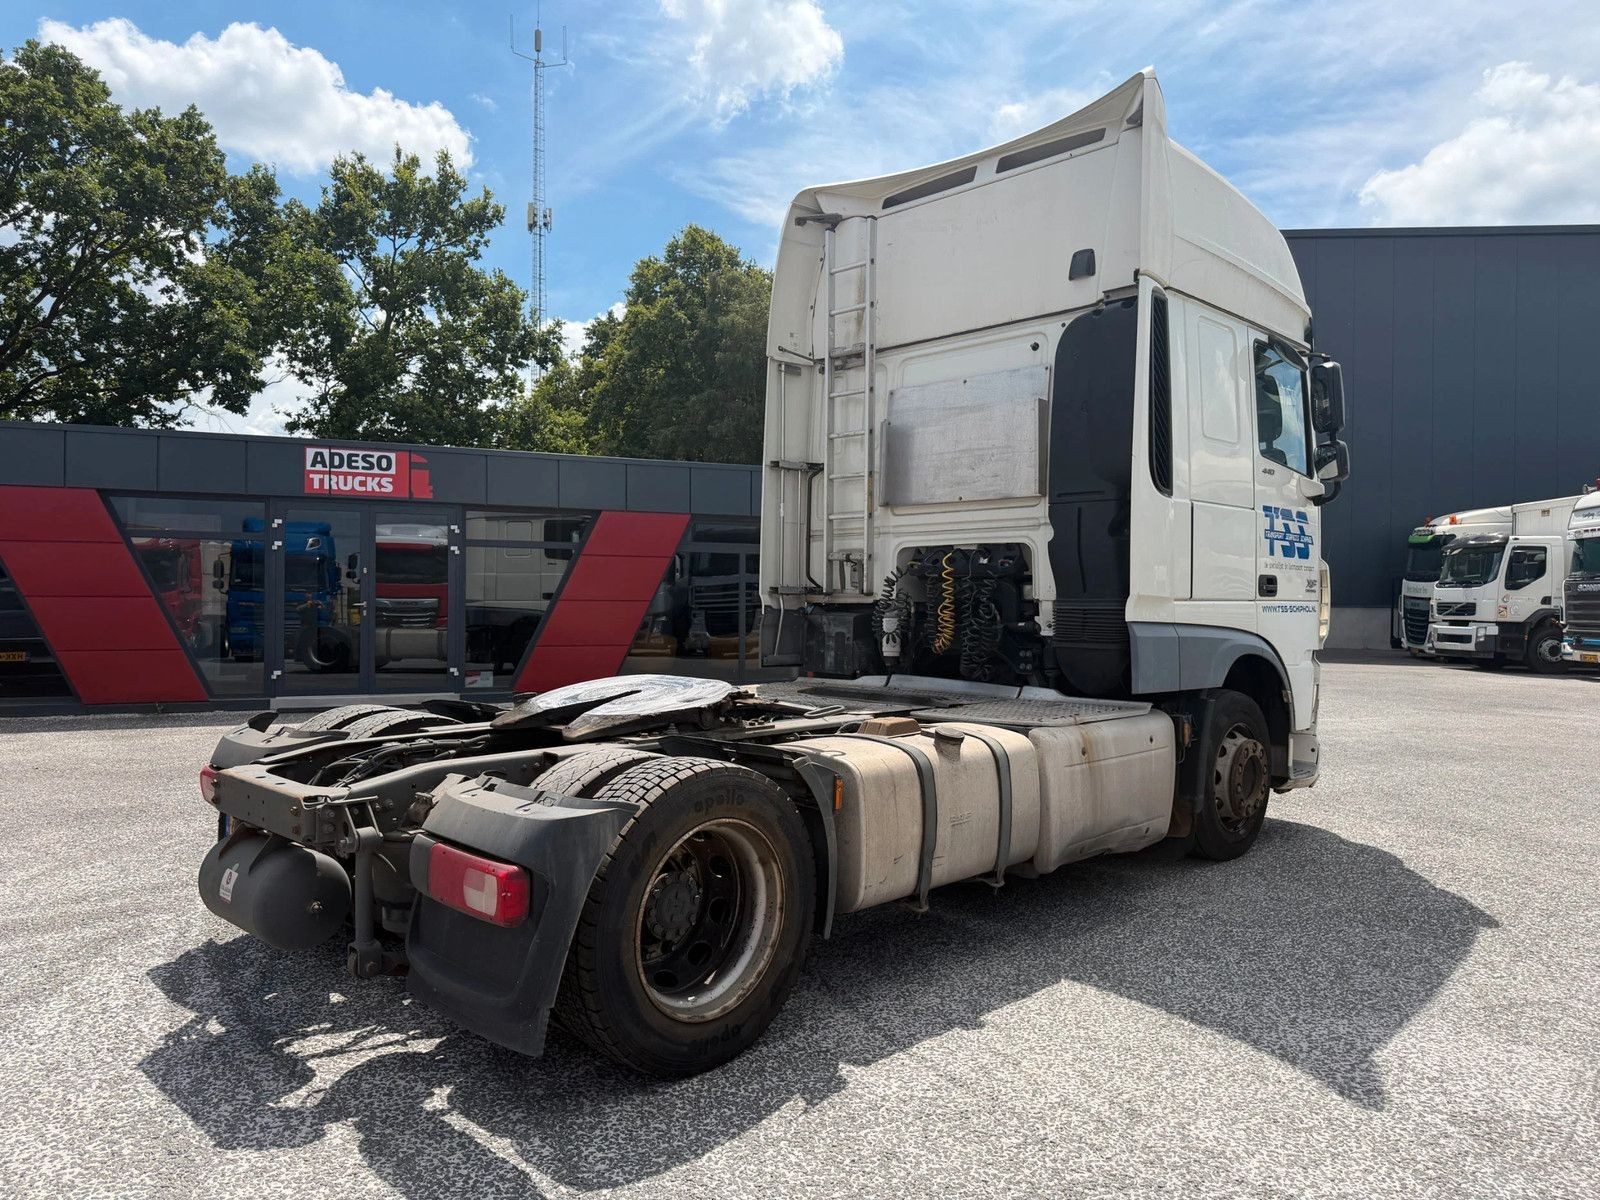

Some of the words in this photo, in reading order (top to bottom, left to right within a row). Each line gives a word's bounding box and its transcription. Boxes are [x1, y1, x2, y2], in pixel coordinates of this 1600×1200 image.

[310, 451, 393, 472] ADESO
[309, 474, 394, 493] TRUCKS
[1262, 505, 1311, 560] TSS
